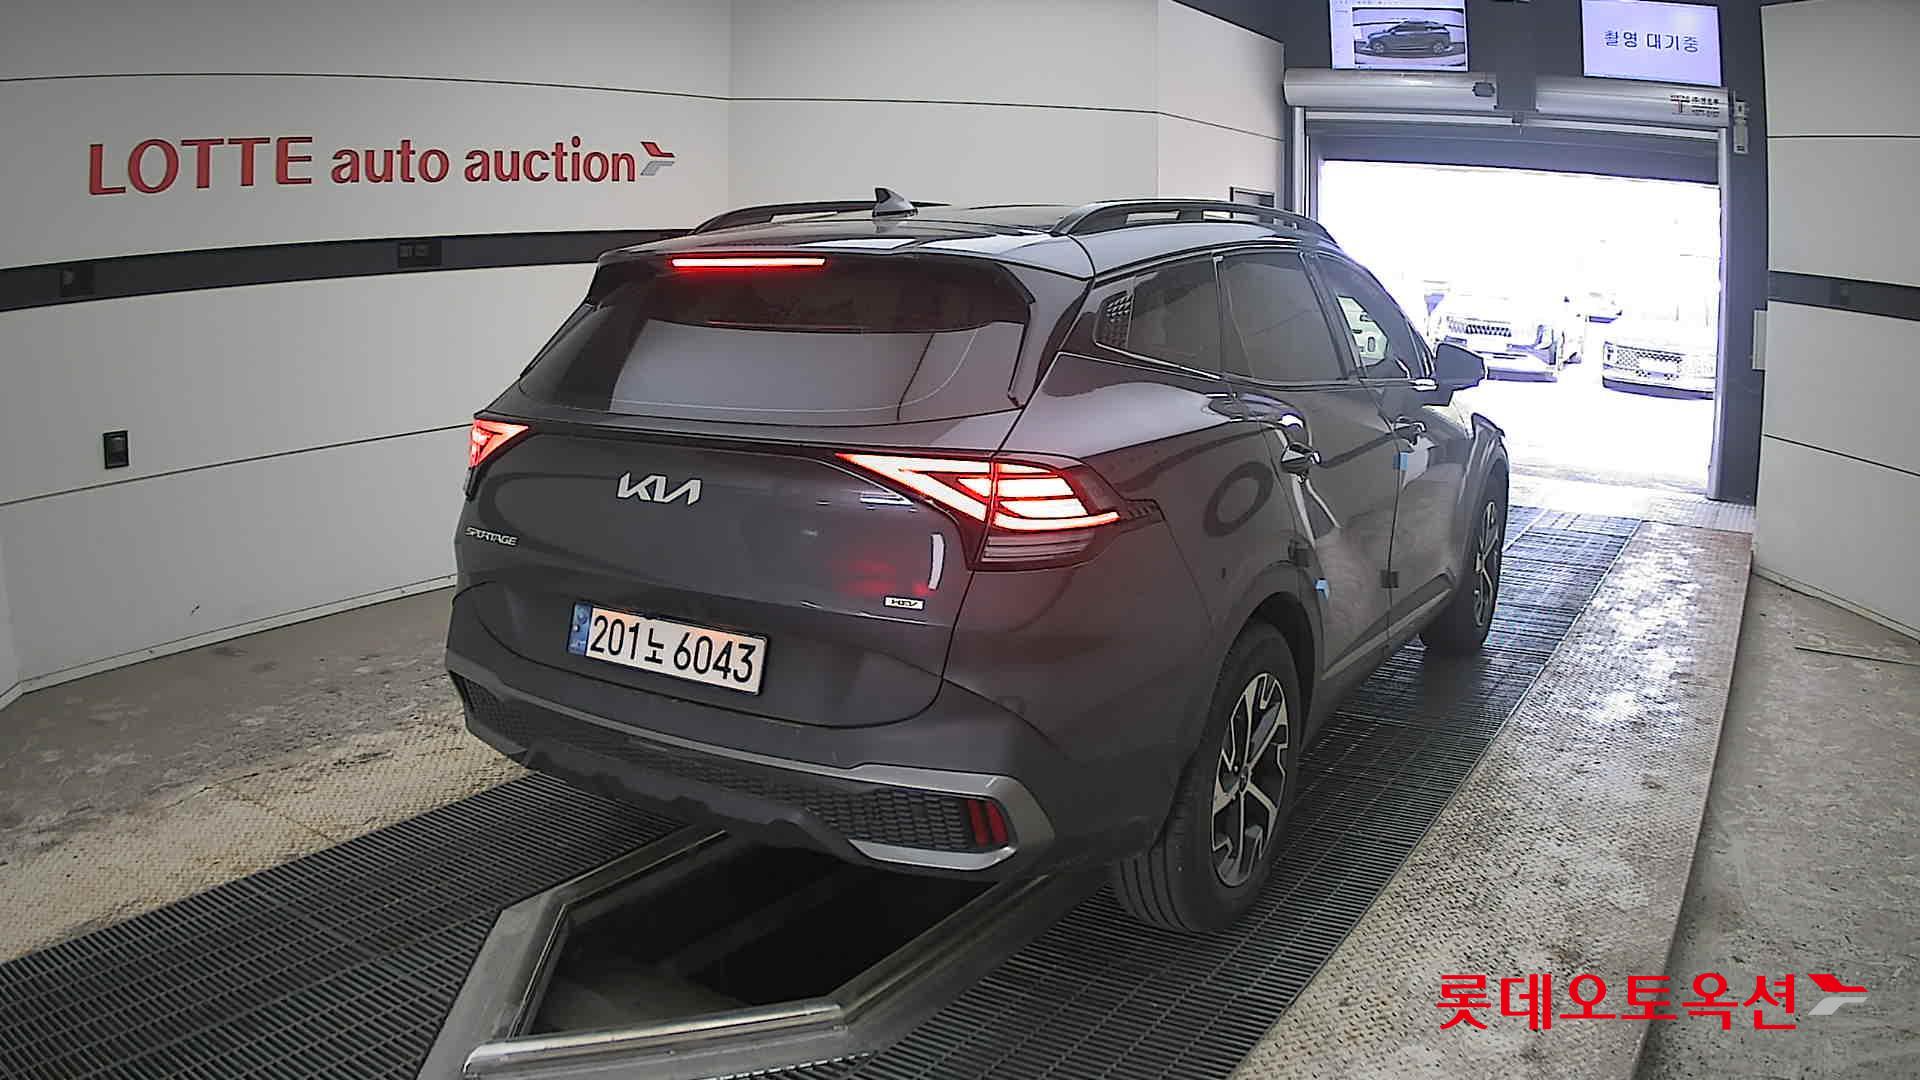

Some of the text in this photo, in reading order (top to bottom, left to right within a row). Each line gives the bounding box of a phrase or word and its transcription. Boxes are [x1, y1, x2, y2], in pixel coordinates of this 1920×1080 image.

[1646, 33, 1698, 53] 대기중
[88, 136, 636, 195] LOTTE auto auction
[465, 526, 518, 547] SPORTAGE
